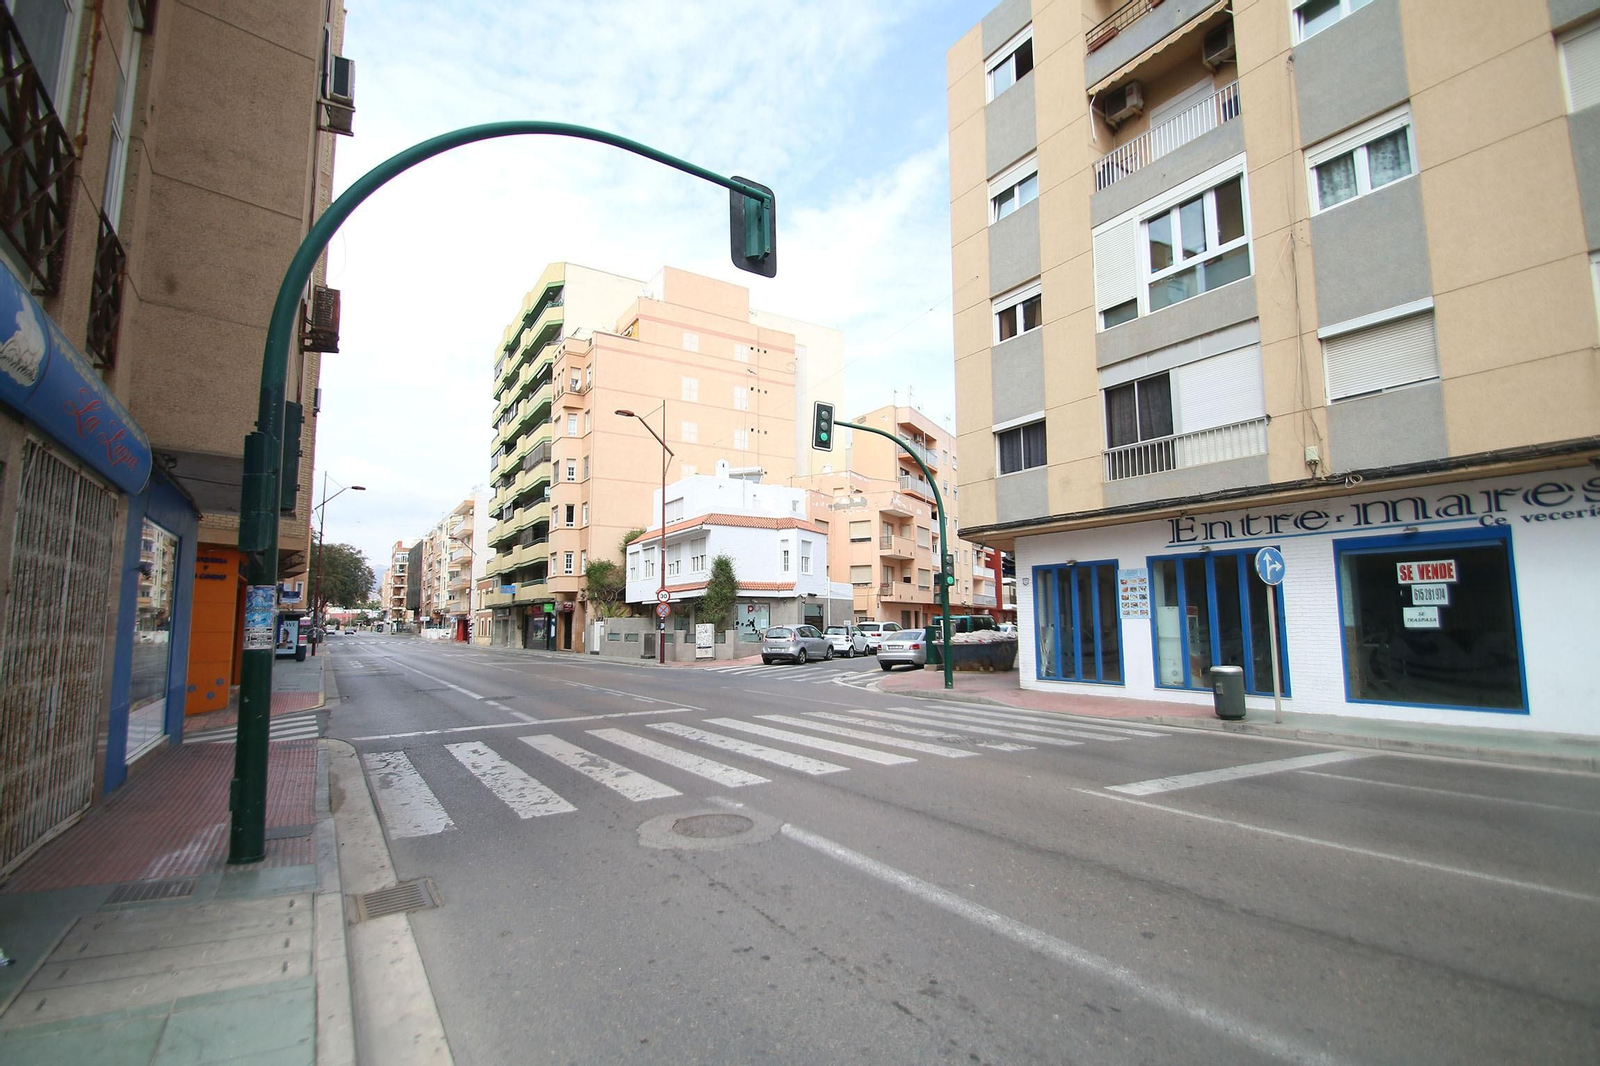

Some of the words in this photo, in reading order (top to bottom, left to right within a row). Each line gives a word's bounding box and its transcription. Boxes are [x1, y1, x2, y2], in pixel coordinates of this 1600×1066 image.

[1520, 504, 1600, 523] vecerí
[1168, 510, 1330, 543] Entre
[1399, 564, 1414, 581] SE
[1417, 562, 1454, 580] VENDE
